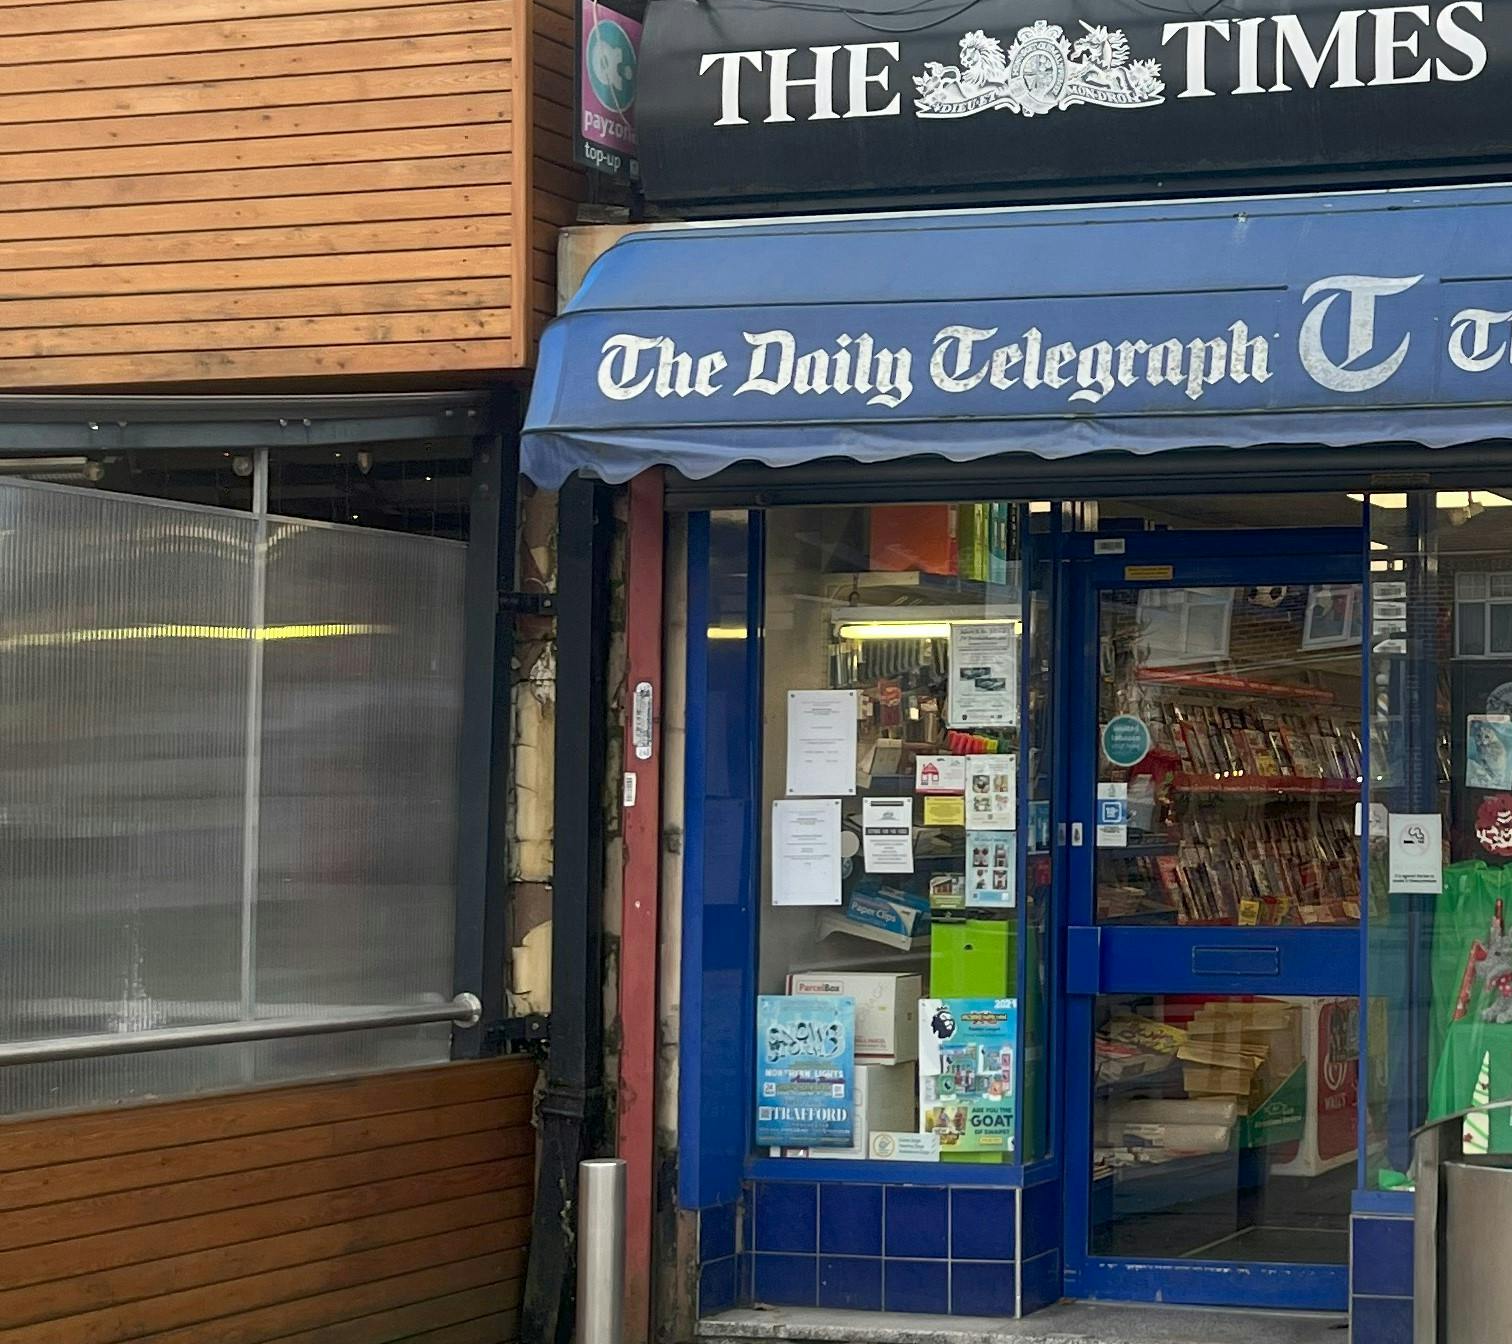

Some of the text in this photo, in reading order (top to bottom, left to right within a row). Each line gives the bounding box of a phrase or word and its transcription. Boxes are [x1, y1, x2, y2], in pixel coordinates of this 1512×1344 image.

[699, 41, 901, 126] THE
[1161, 1, 1488, 98] TIMES
[584, 142, 622, 172] top-up
[597, 333, 728, 400] The
[733, 330, 913, 408] Daily
[929, 319, 1275, 403] Telegraph
[851, 901, 875, 916] Paper
[799, 983, 840, 993] ParcelBox
[970, 1114, 1014, 1127] GOAT
